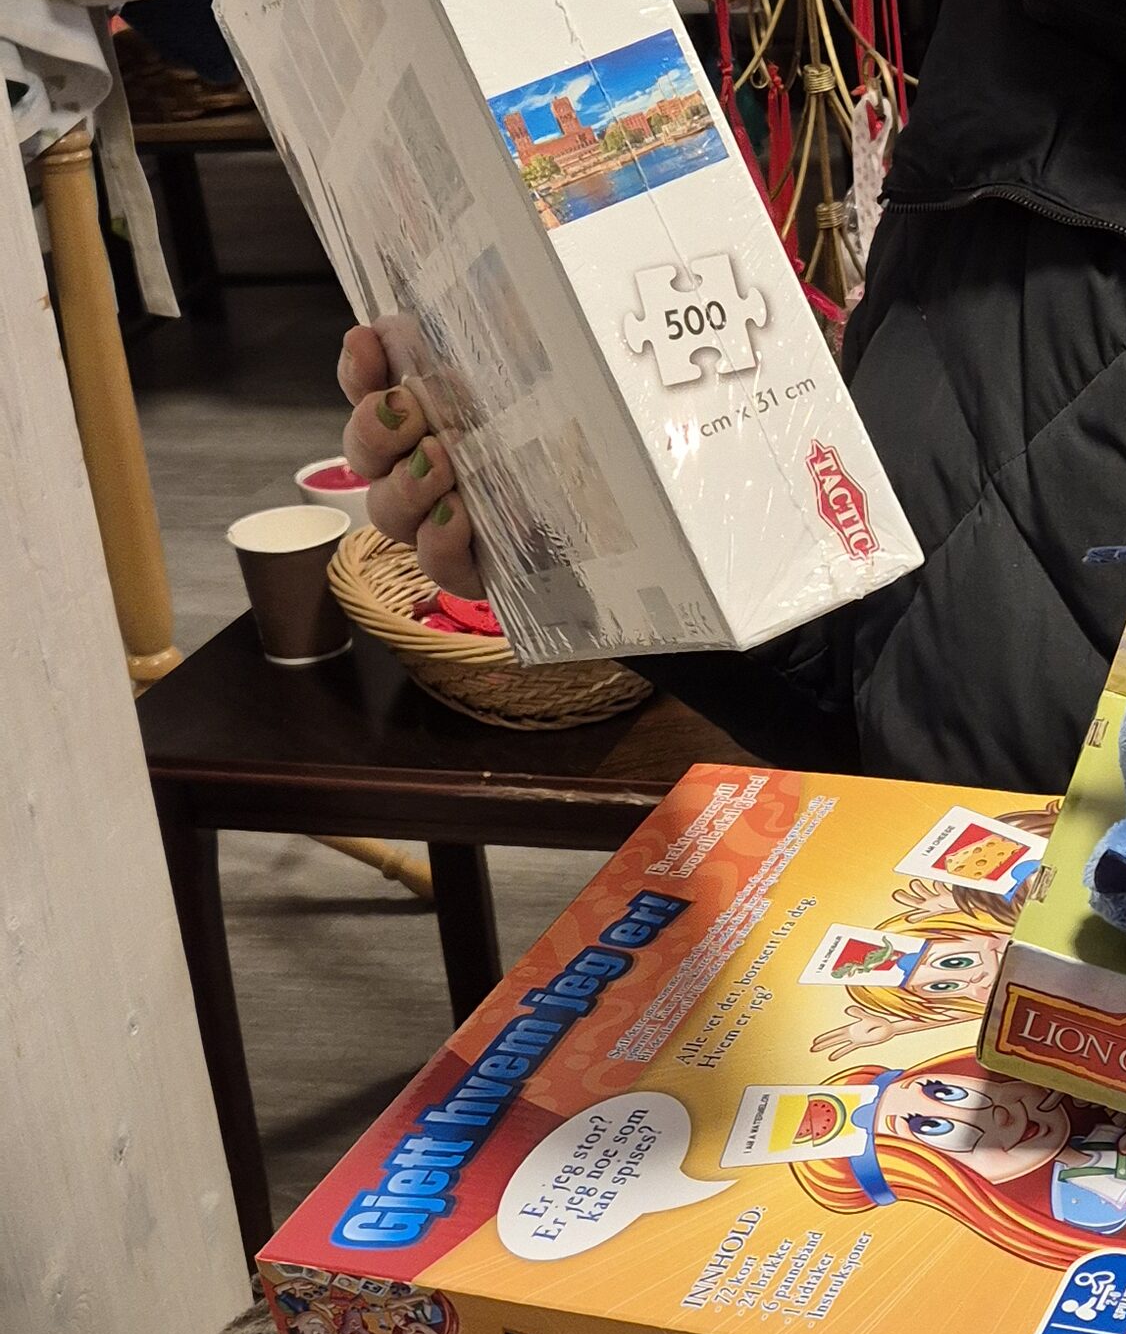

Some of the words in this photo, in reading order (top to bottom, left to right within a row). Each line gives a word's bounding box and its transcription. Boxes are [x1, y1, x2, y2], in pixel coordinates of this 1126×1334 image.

[664, 300, 727, 341] 500
[700, 414, 732, 438] cm
[755, 387, 780, 414] 31
[784, 377, 817, 400] cm
[814, 452, 873, 558] TACTIC
[696, 831, 724, 851] alle
[712, 808, 743, 830] skal
[676, 1036, 708, 1065] Alle
[702, 1013, 725, 1031] vet
[732, 938, 782, 985] bortsett
[771, 920, 797, 936] fra
[789, 896, 816, 917] deg.
[742, 985, 773, 1010] jeg?
[696, 1028, 741, 1068] Hvem
[734, 1012, 752, 1025] er
[1017, 1007, 1117, 1065] LION
[341, 1137, 475, 1240] Gjett
[423, 1018, 564, 1125] hvem
[530, 951, 624, 1012] jeg
[610, 894, 680, 941] er!
[517, 1194, 556, 1218] Er
[542, 1163, 584, 1191] jeg
[571, 1115, 612, 1160] stor?
[531, 1217, 567, 1241] Er
[555, 1184, 598, 1213] jeg
[584, 1147, 620, 1180] noe
[610, 1109, 649, 1144] som
[576, 1190, 618, 1223] kan
[610, 1124, 662, 1185] spises?
[682, 1205, 767, 1307] INNHOLD:
[713, 1286, 738, 1303] 72
[727, 1255, 758, 1284] kort
[736, 1289, 762, 1307] 24
[750, 1238, 793, 1287] brikker
[760, 1299, 780, 1310] 6
[773, 1230, 823, 1299] pannebånd
[794, 1253, 834, 1304] tidtaker
[806, 1231, 872, 1318] Instruksjoner
